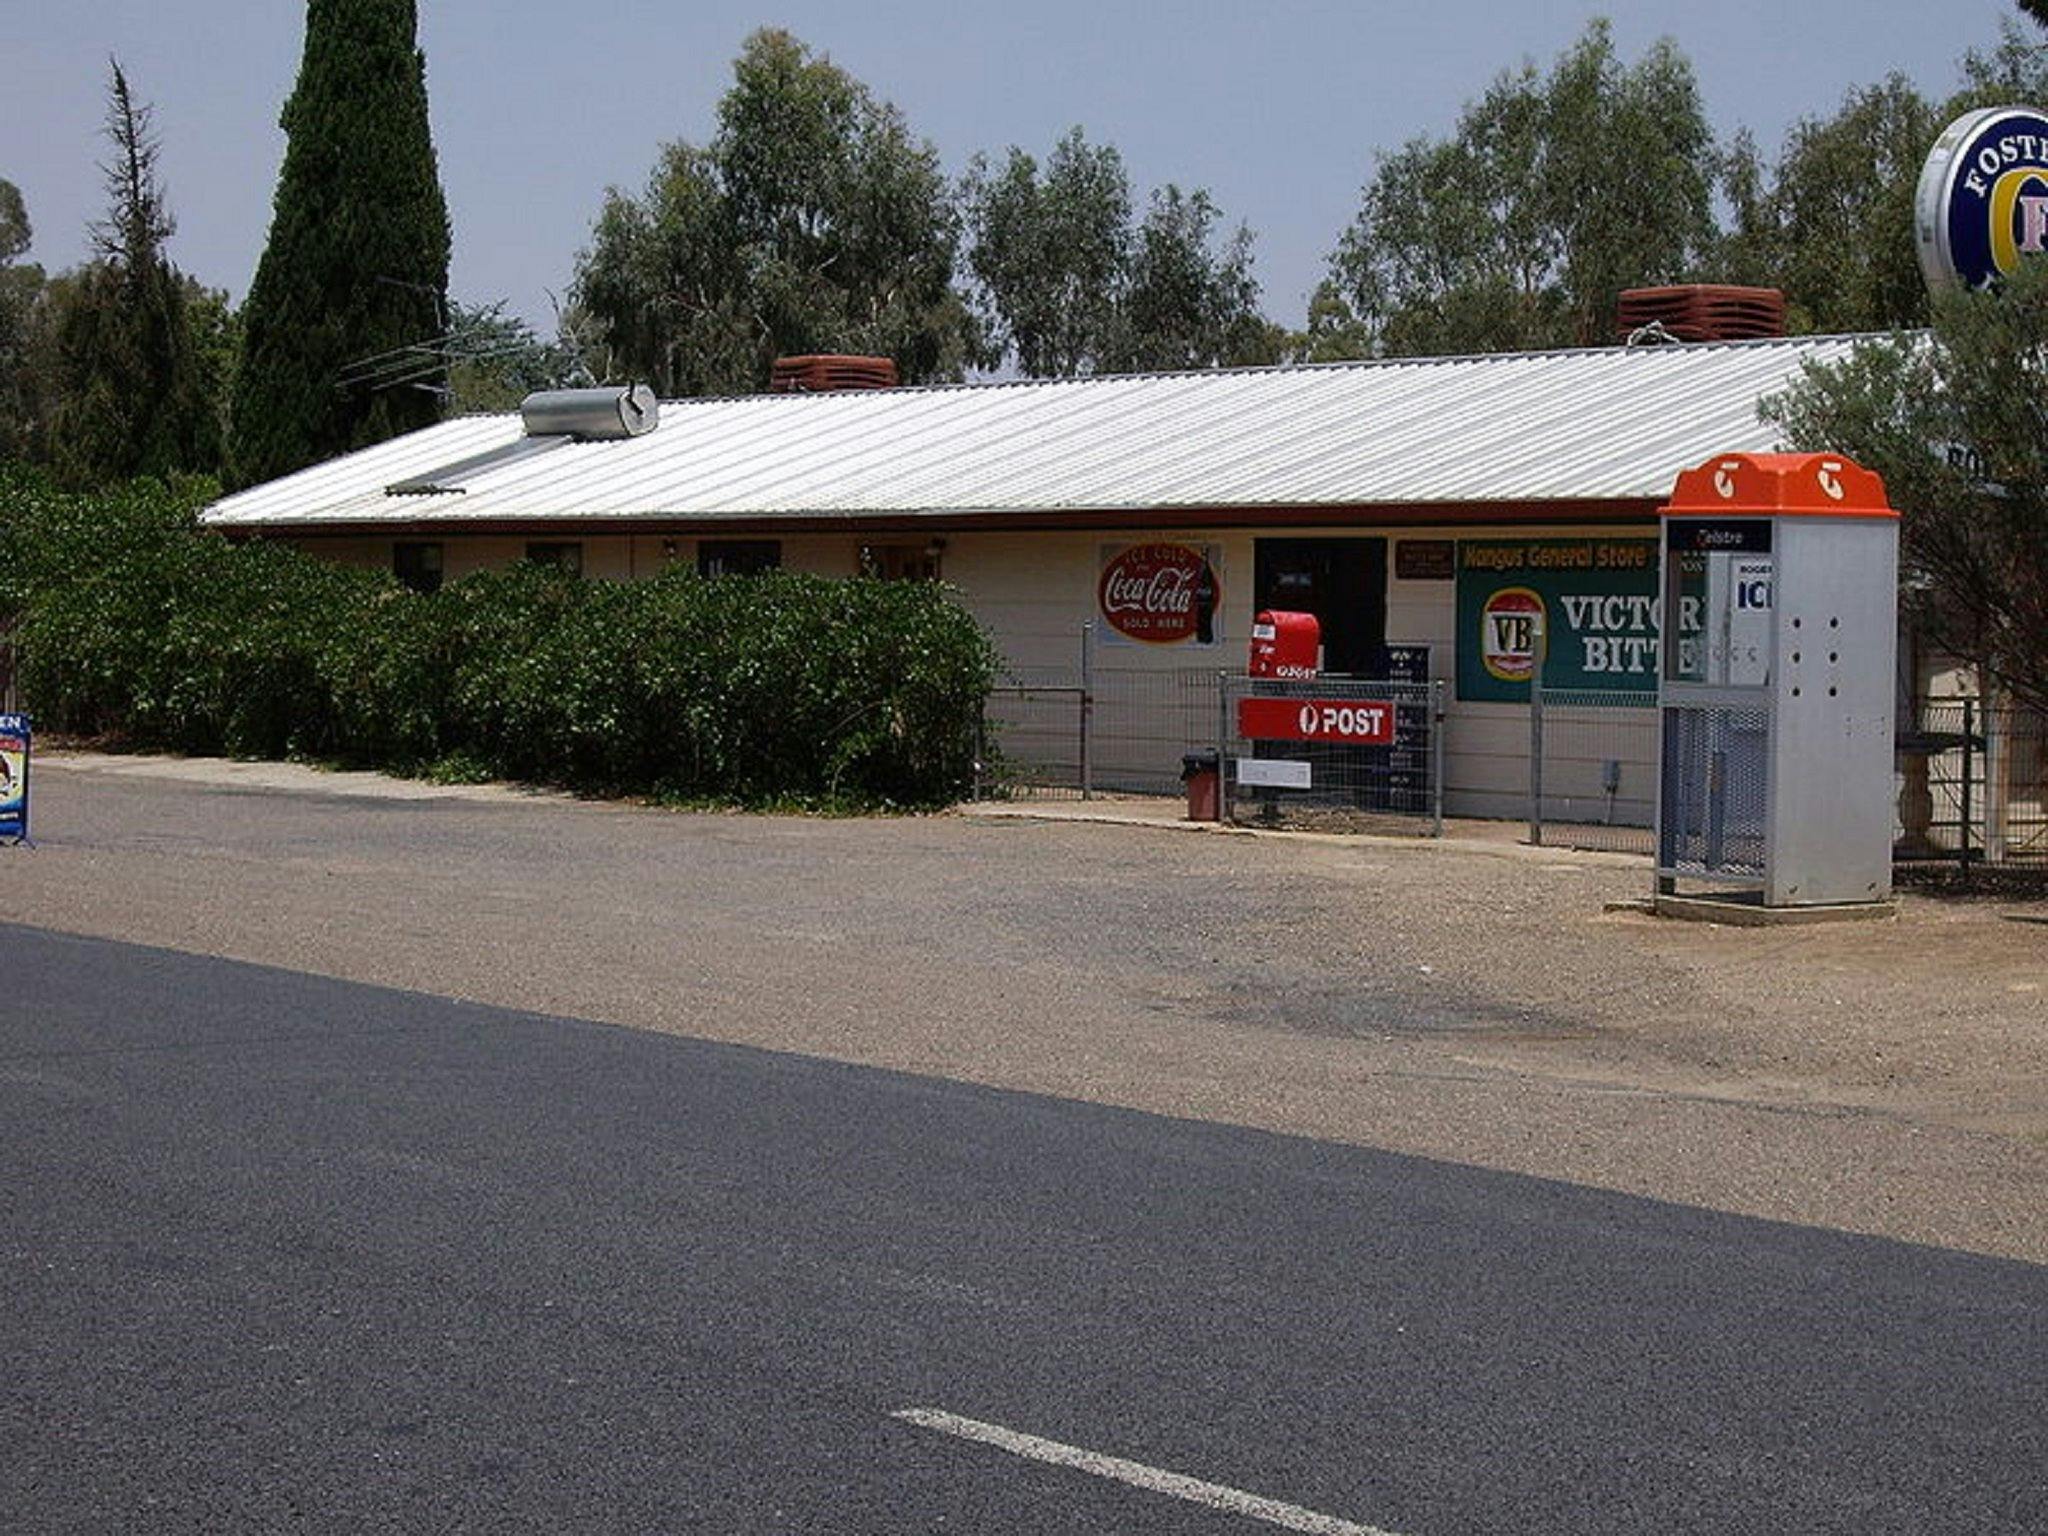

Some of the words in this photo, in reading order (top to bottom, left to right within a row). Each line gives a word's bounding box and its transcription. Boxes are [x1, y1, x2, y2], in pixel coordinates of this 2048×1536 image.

[1699, 529, 1743, 544] Telstra
[1527, 545, 1592, 567] General
[1597, 545, 1648, 567] Store
[1492, 615, 1533, 651] VB
[1323, 708, 1384, 736] POST
